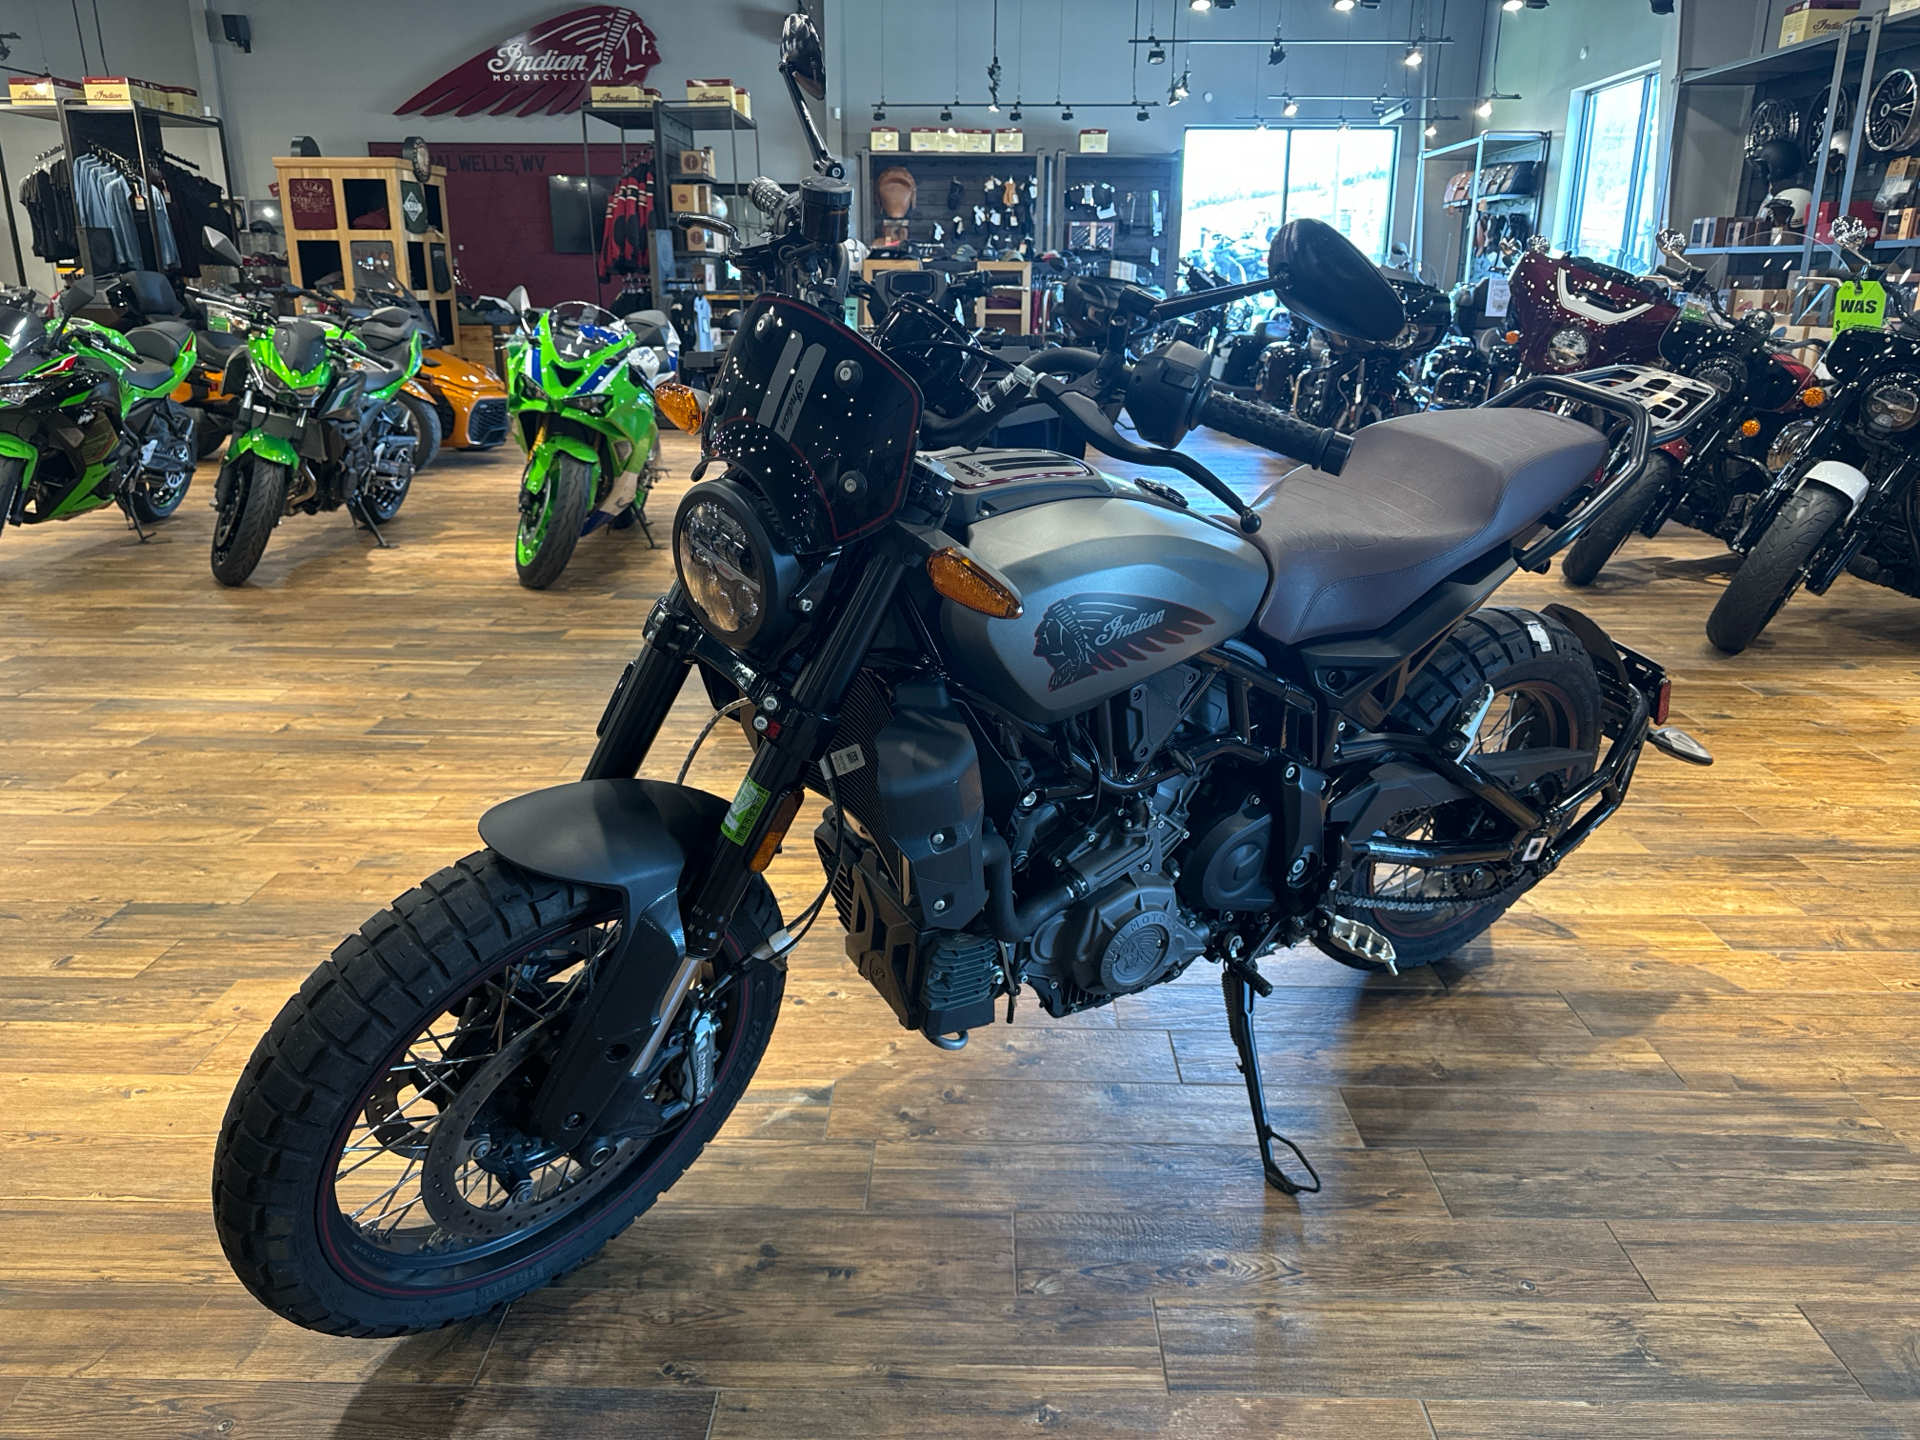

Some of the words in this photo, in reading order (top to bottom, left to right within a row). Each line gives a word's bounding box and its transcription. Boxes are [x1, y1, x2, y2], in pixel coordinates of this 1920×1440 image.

[493, 74, 586, 82] MOTORCYCLE
[94, 90, 122, 99] Indian
[1841, 300, 1878, 313] WAS
[780, 379, 804, 433] Indian
[1095, 609, 1166, 647] Indian
[697, 1049, 710, 1095] brembo
